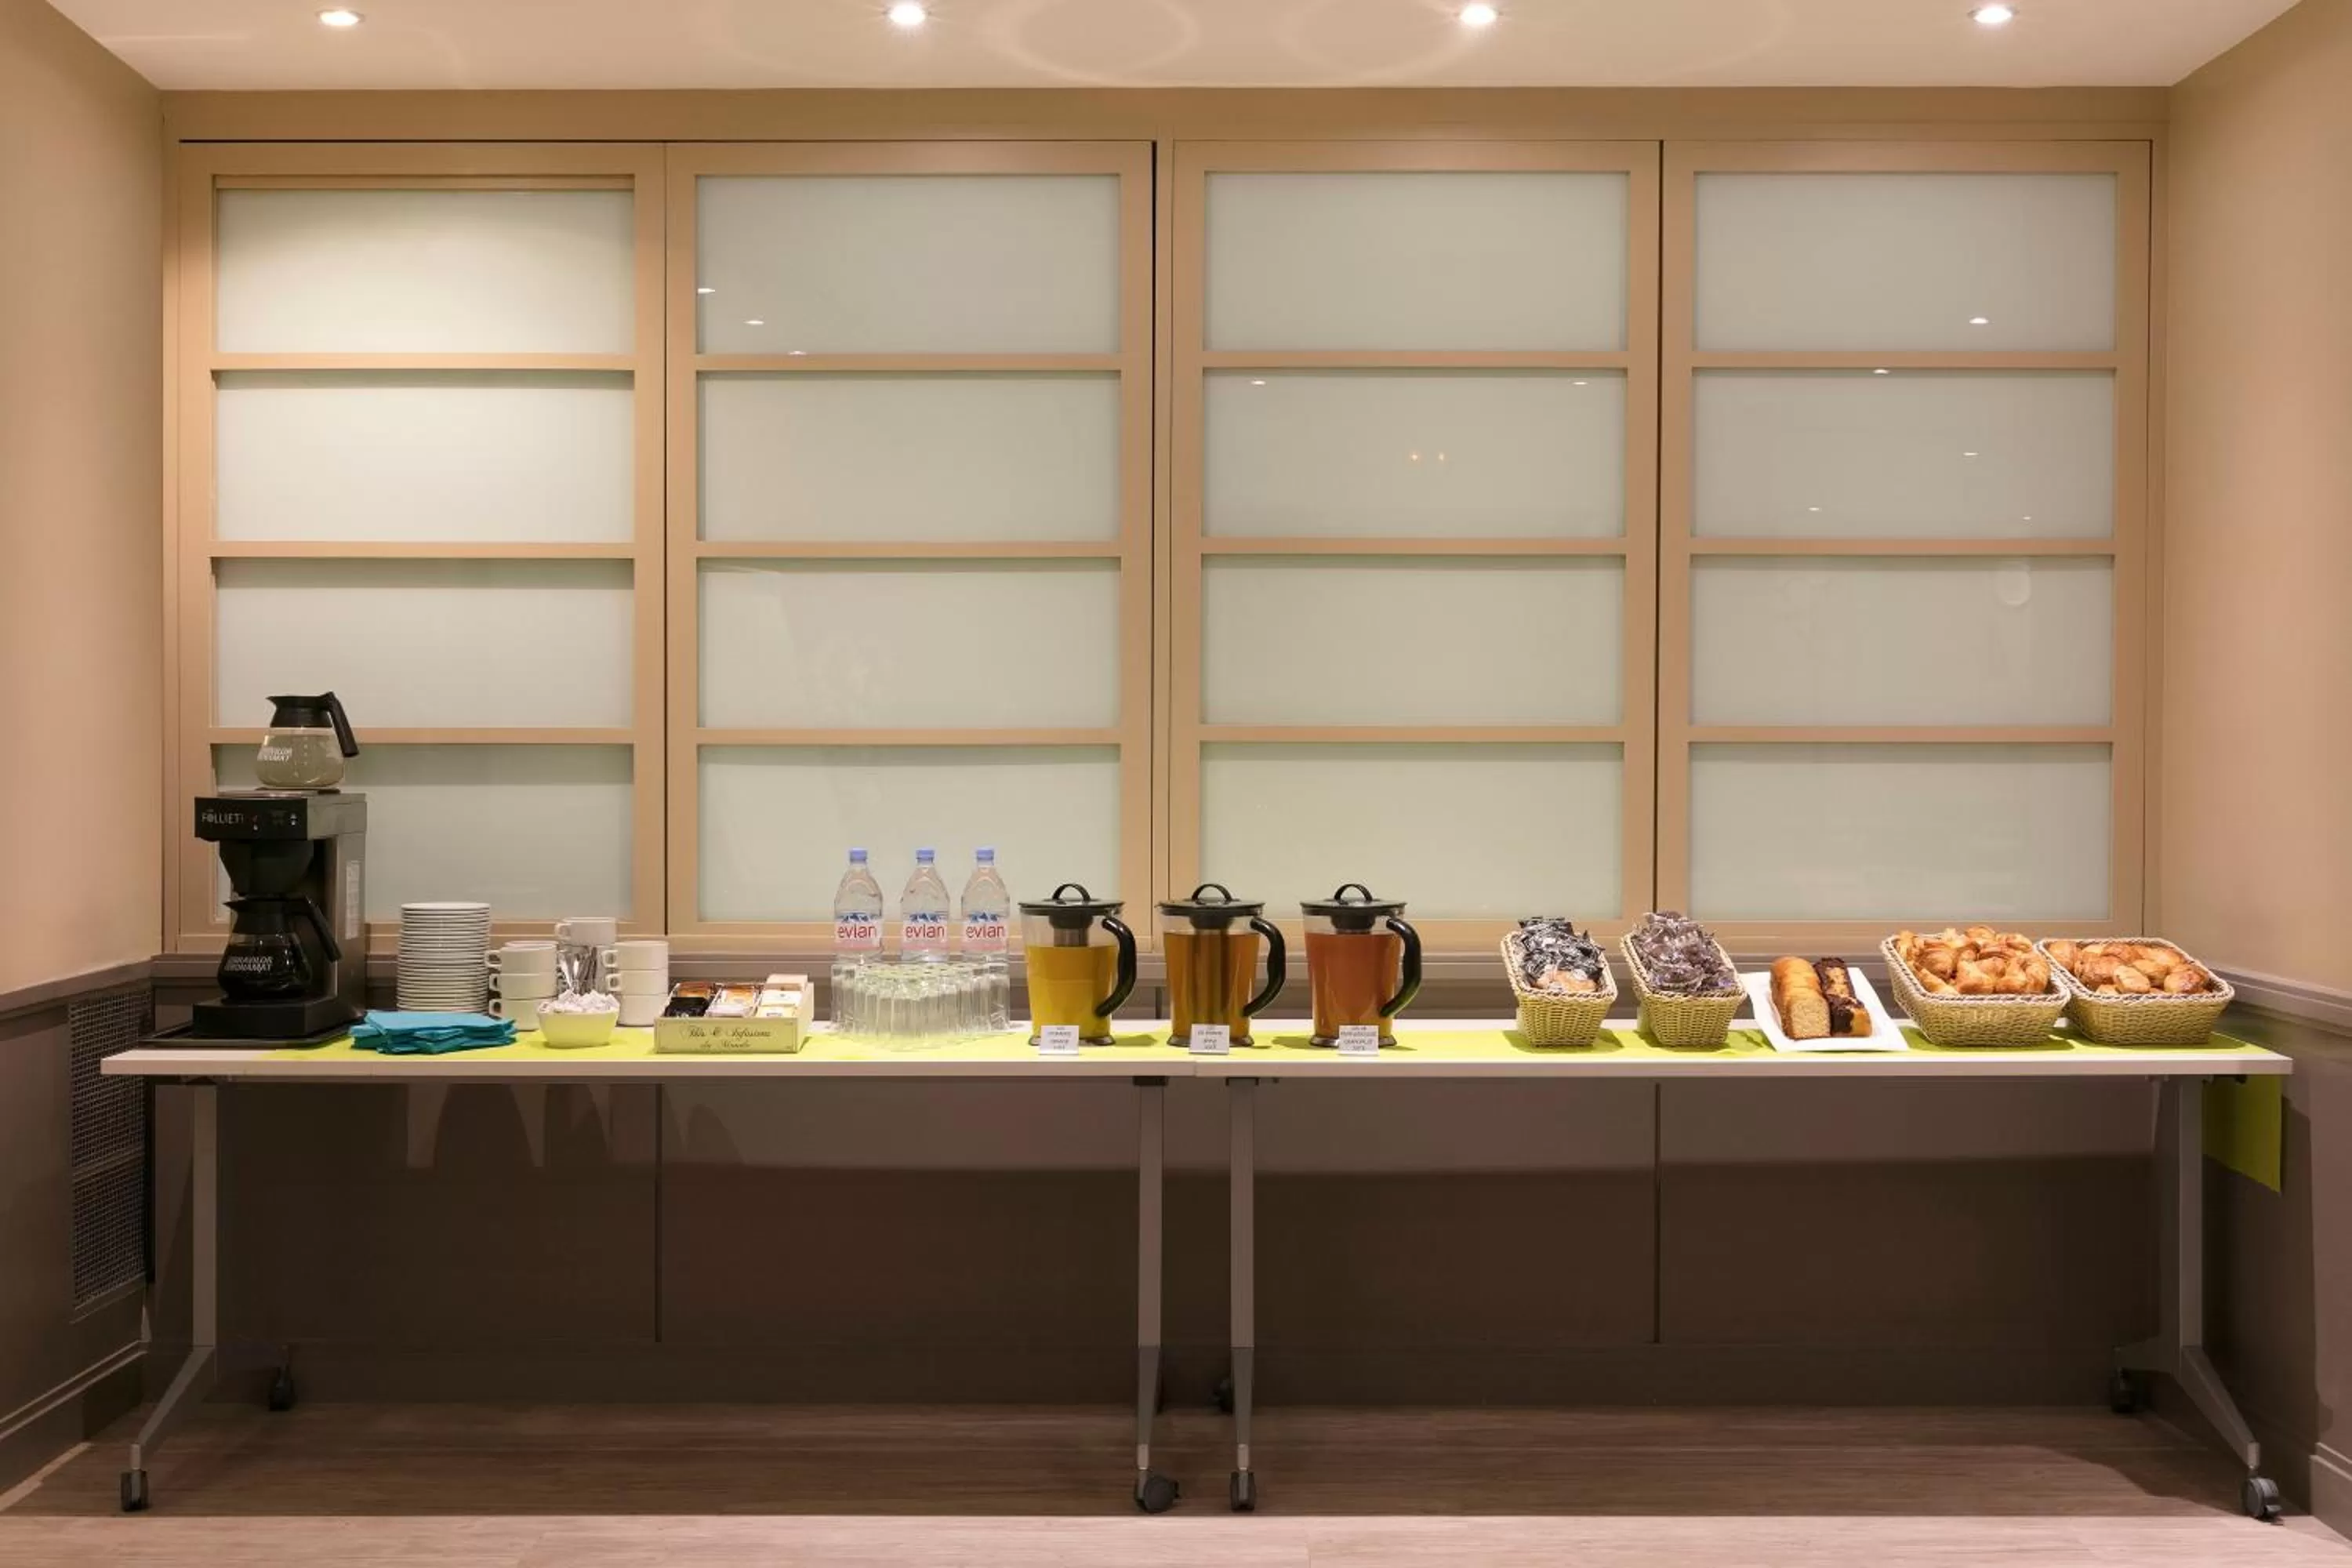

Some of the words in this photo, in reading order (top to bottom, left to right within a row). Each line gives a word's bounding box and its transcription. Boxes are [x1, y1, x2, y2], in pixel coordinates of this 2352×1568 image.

[837, 924, 877, 938] evian
[906, 924, 945, 938] evian
[965, 924, 1005, 938] evian
